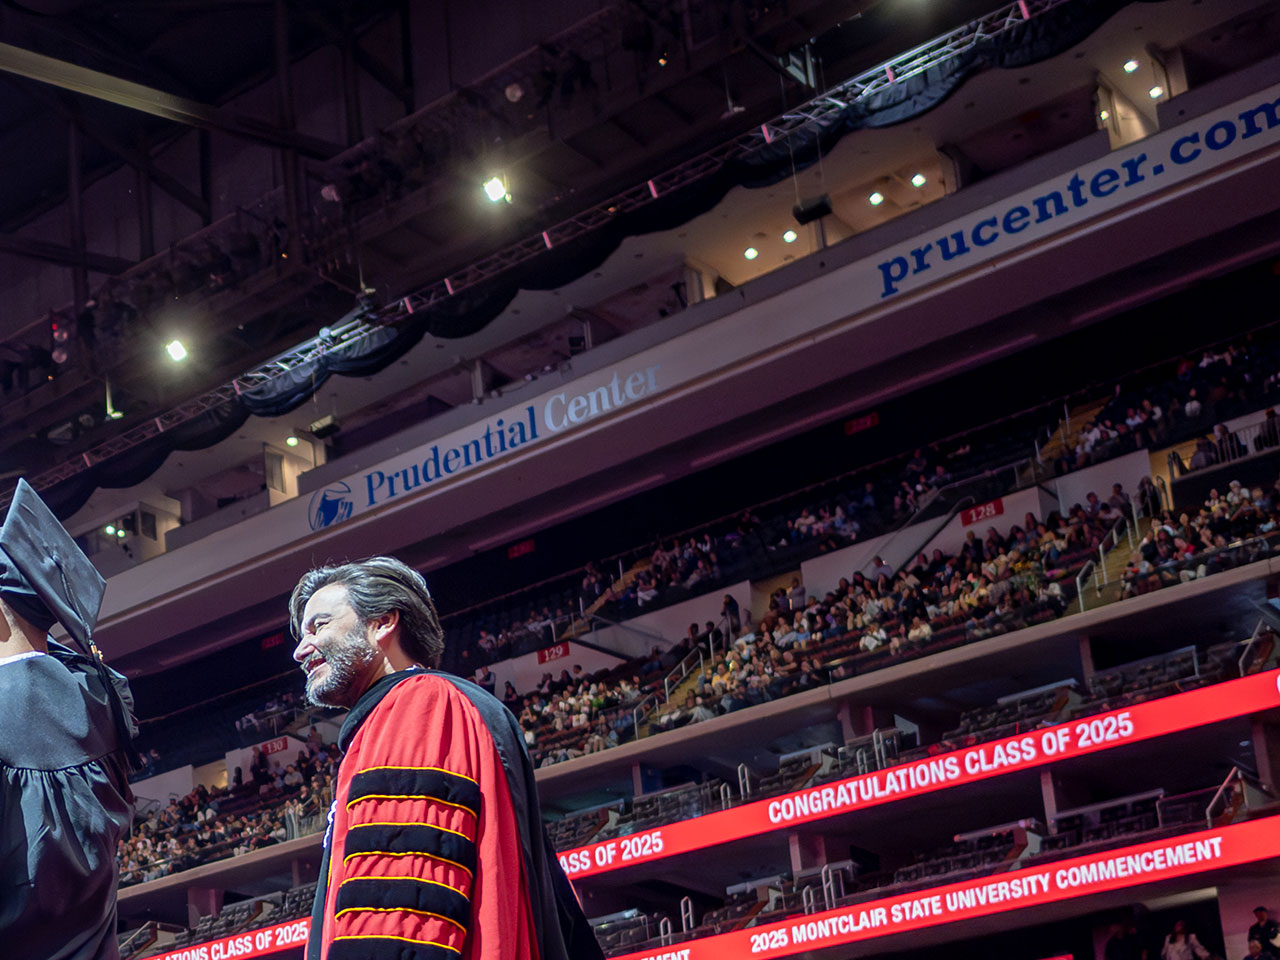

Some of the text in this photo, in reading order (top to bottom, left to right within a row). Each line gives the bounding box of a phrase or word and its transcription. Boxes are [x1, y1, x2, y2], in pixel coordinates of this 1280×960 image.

[364, 362, 662, 507] Prudential Center
[968, 503, 996, 522] 128
[543, 644, 564, 662] 129
[768, 711, 1135, 824] CONGRATULATIONS CLASS OF 2025
[594, 843, 617, 867] OF
[620, 831, 664, 861] 2025
[749, 836, 1223, 953] 2025 MONTCLAIR STATE UNIVERSITY COMMENCEMENT
[256, 930, 273, 950] OF
[276, 920, 309, 946] 2025
